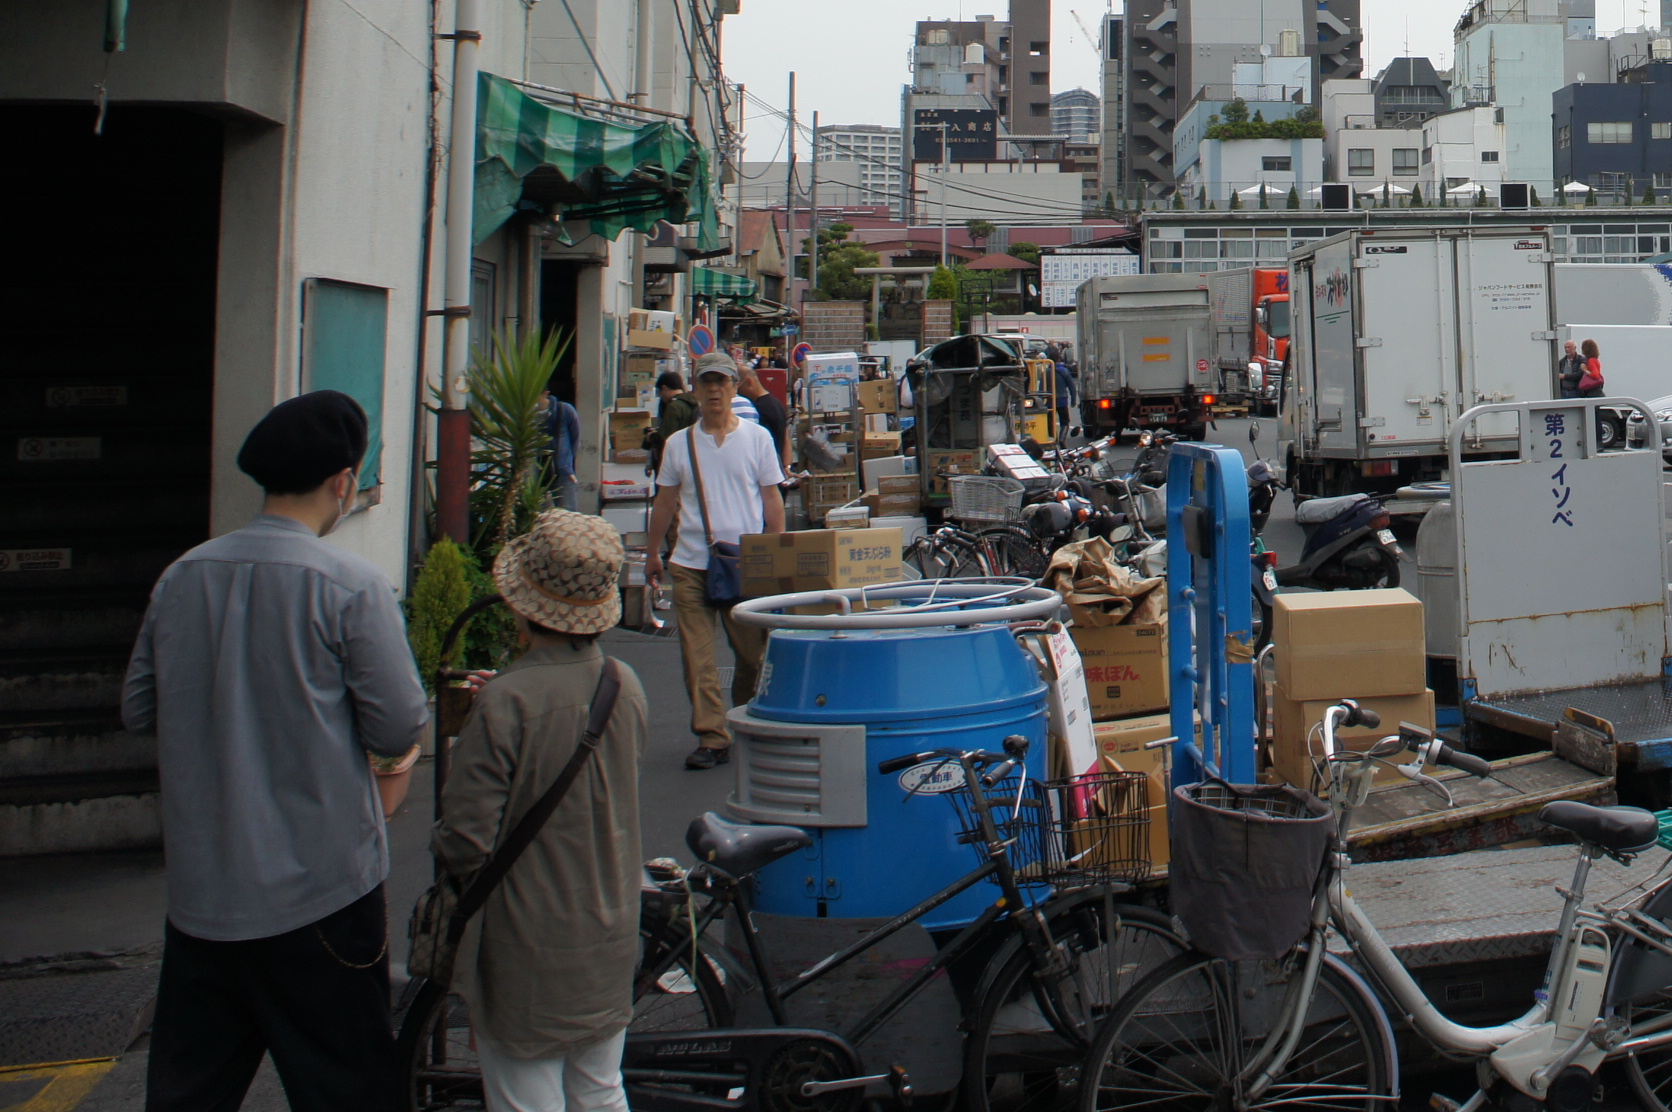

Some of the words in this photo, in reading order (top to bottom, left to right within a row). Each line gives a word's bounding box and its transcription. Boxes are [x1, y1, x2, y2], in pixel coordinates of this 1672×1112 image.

[849, 547, 891, 561] 黄金天ぷら粉
